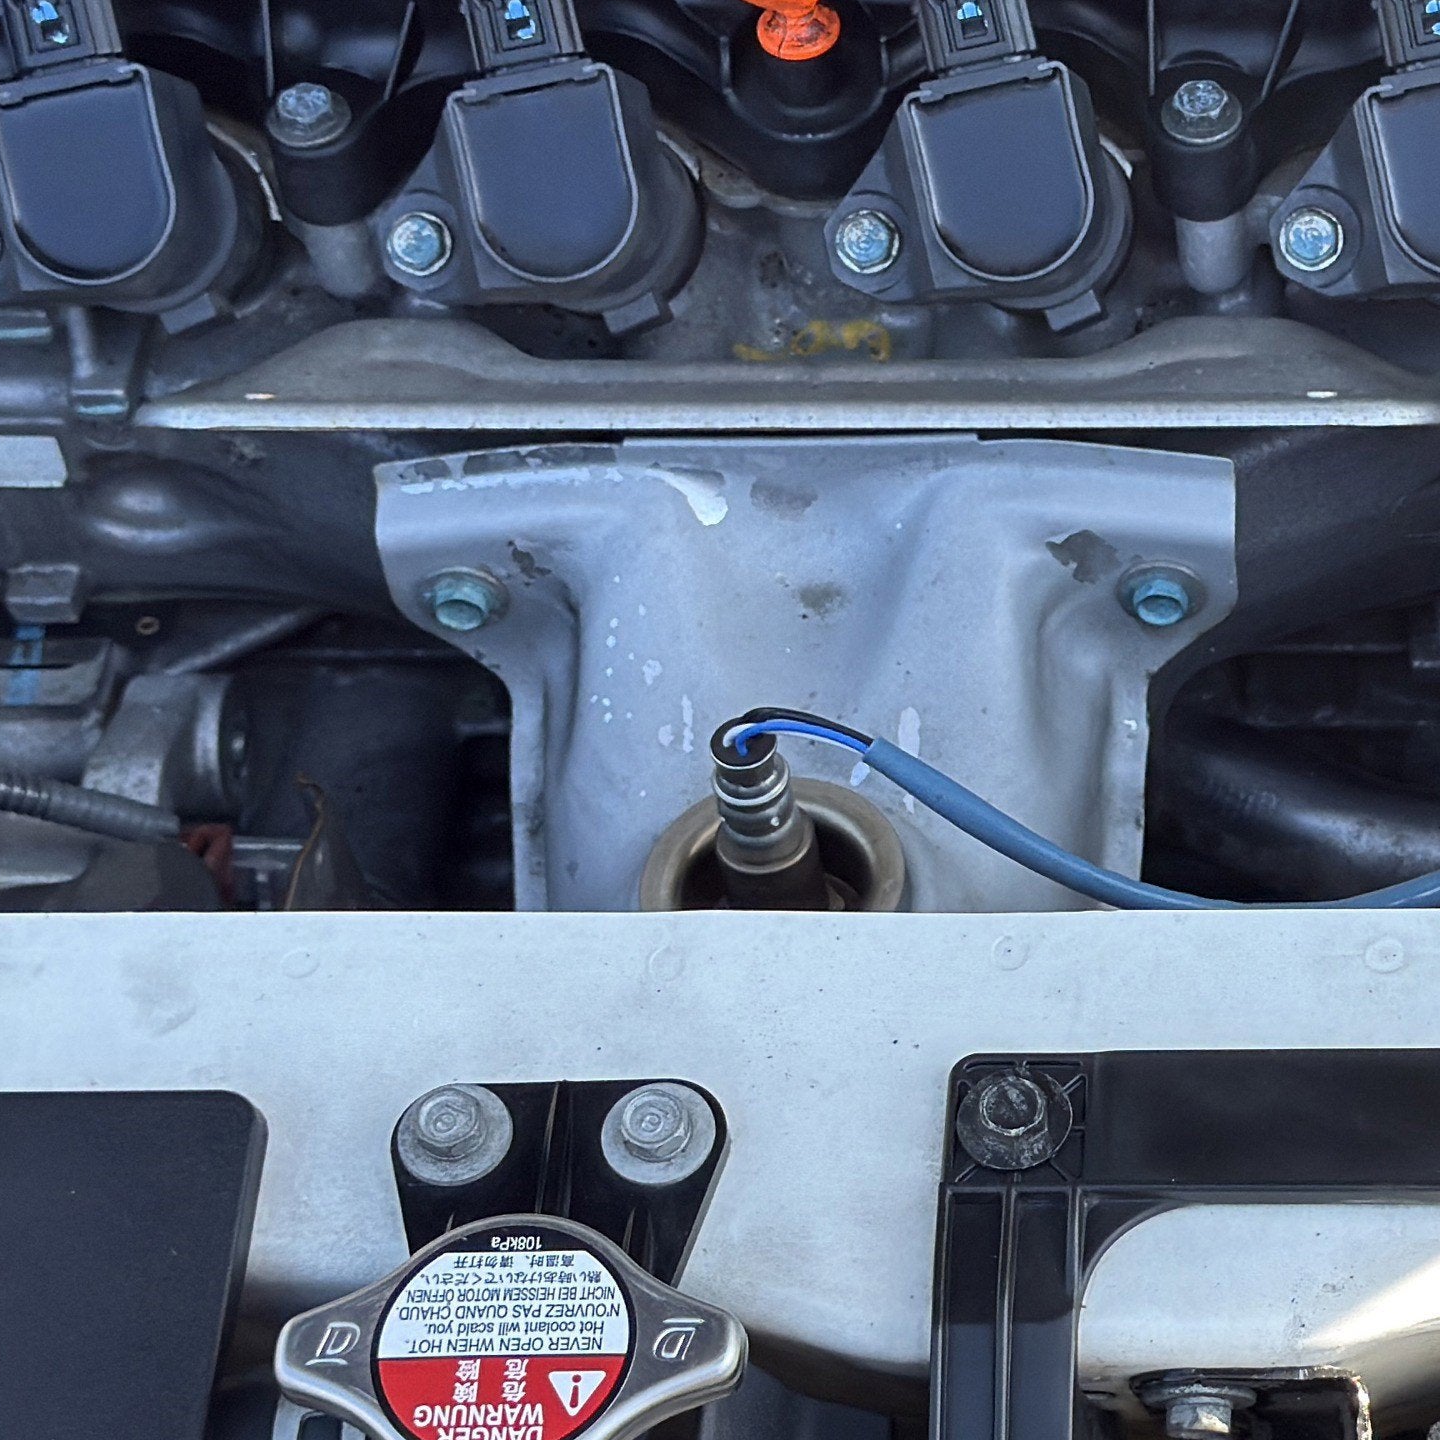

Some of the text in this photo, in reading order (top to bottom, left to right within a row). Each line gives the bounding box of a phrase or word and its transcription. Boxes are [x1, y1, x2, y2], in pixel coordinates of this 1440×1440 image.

[490, 1235, 542, 1250] 108kPa
[419, 1270, 601, 1284] 熱い時あけないでください。
[458, 1287, 500, 1302] MOTOR
[502, 1287, 554, 1300] HEISSEM
[558, 1286, 576, 1300] BEI
[580, 1285, 614, 1300] NICHT
[395, 1302, 619, 1320] N'OUVREZ PAS QUAND CHAUD.
[424, 1319, 603, 1335] Hot coolant will scald you.
[405, 1336, 602, 1353] NEVER OPEN WHEN HOT.
[412, 1403, 543, 1426] WARNUNG
